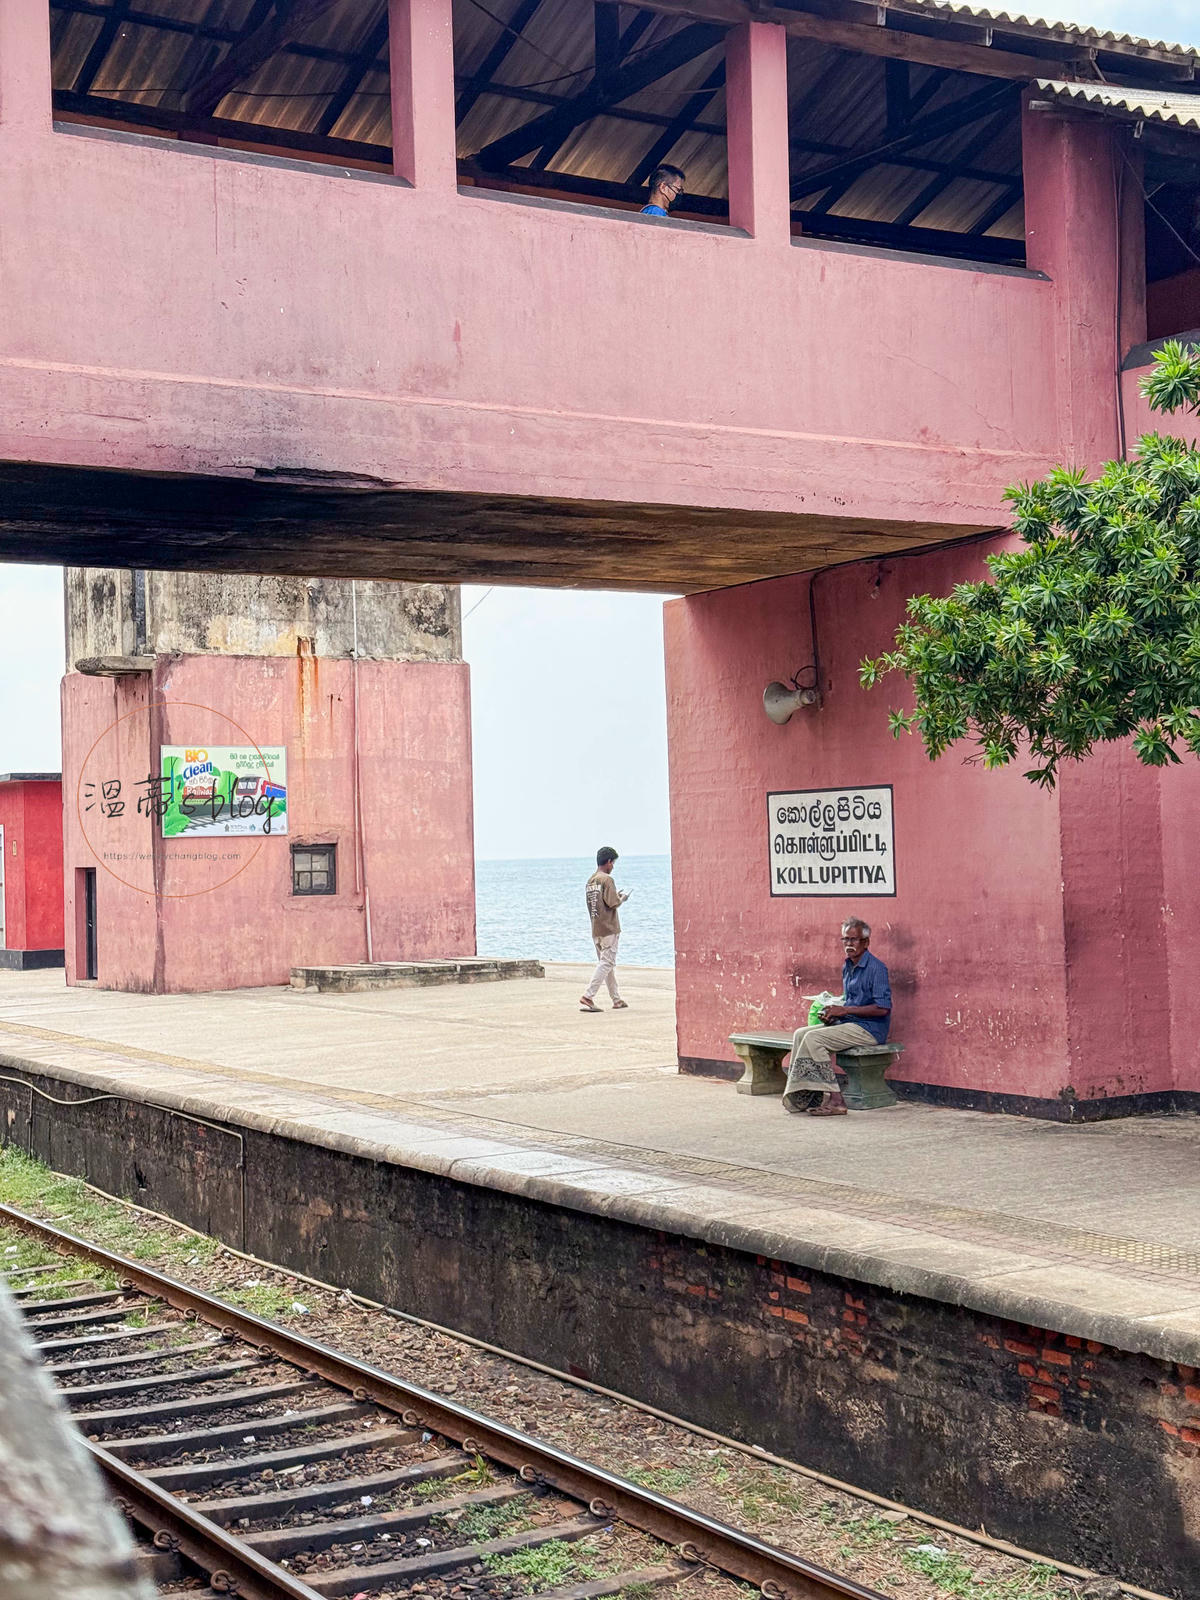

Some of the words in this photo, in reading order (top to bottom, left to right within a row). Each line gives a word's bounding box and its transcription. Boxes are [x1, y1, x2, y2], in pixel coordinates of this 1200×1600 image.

[777, 796, 882, 832] කොල්ලුපිටිය
[775, 829, 887, 861] கொள்ளுப்பிட்டி
[776, 865, 887, 884] KOLLUPITIYA
